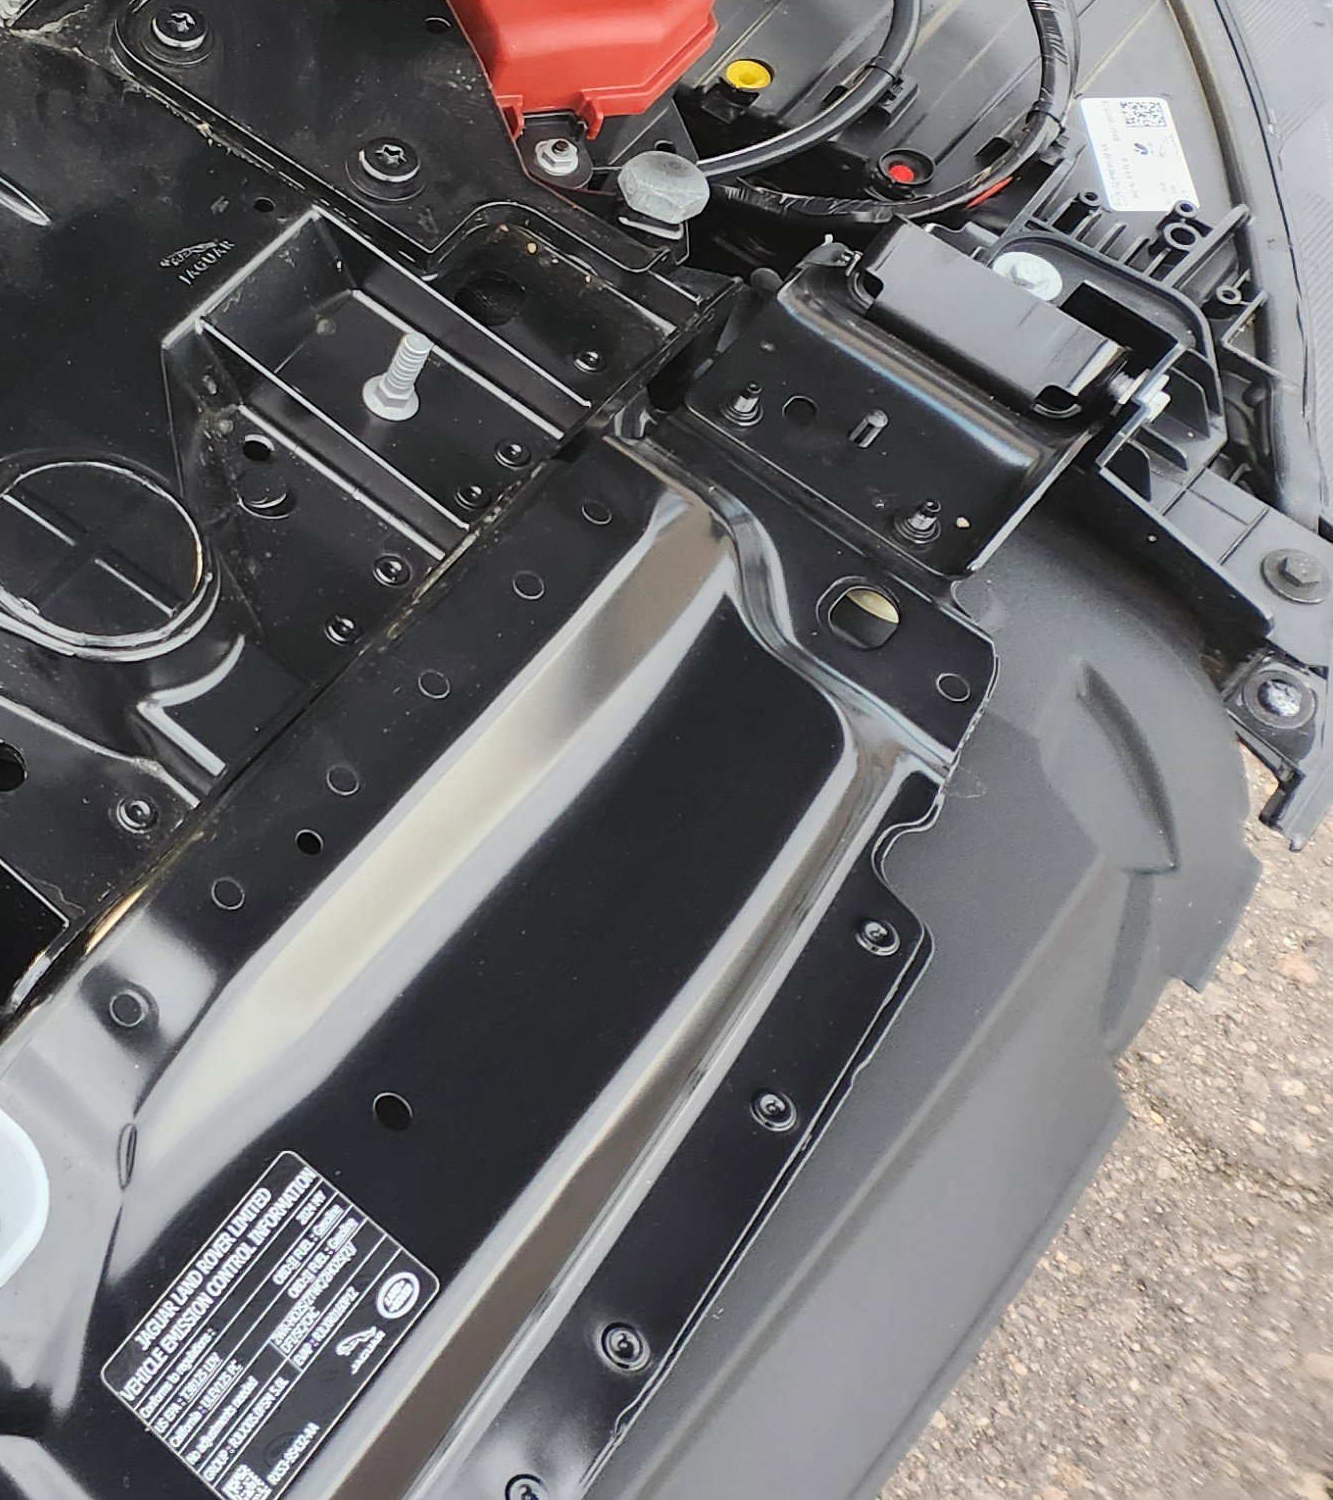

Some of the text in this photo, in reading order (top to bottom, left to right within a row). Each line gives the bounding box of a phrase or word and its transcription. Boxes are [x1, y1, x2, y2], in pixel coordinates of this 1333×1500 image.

[118, 1165, 316, 1404] VEHICLE EMISSION CONTROL INFORMATION
[134, 1186, 272, 1351] JAGUAR LAND ROVER LIMITED
[167, 1370, 180, 1384] to
